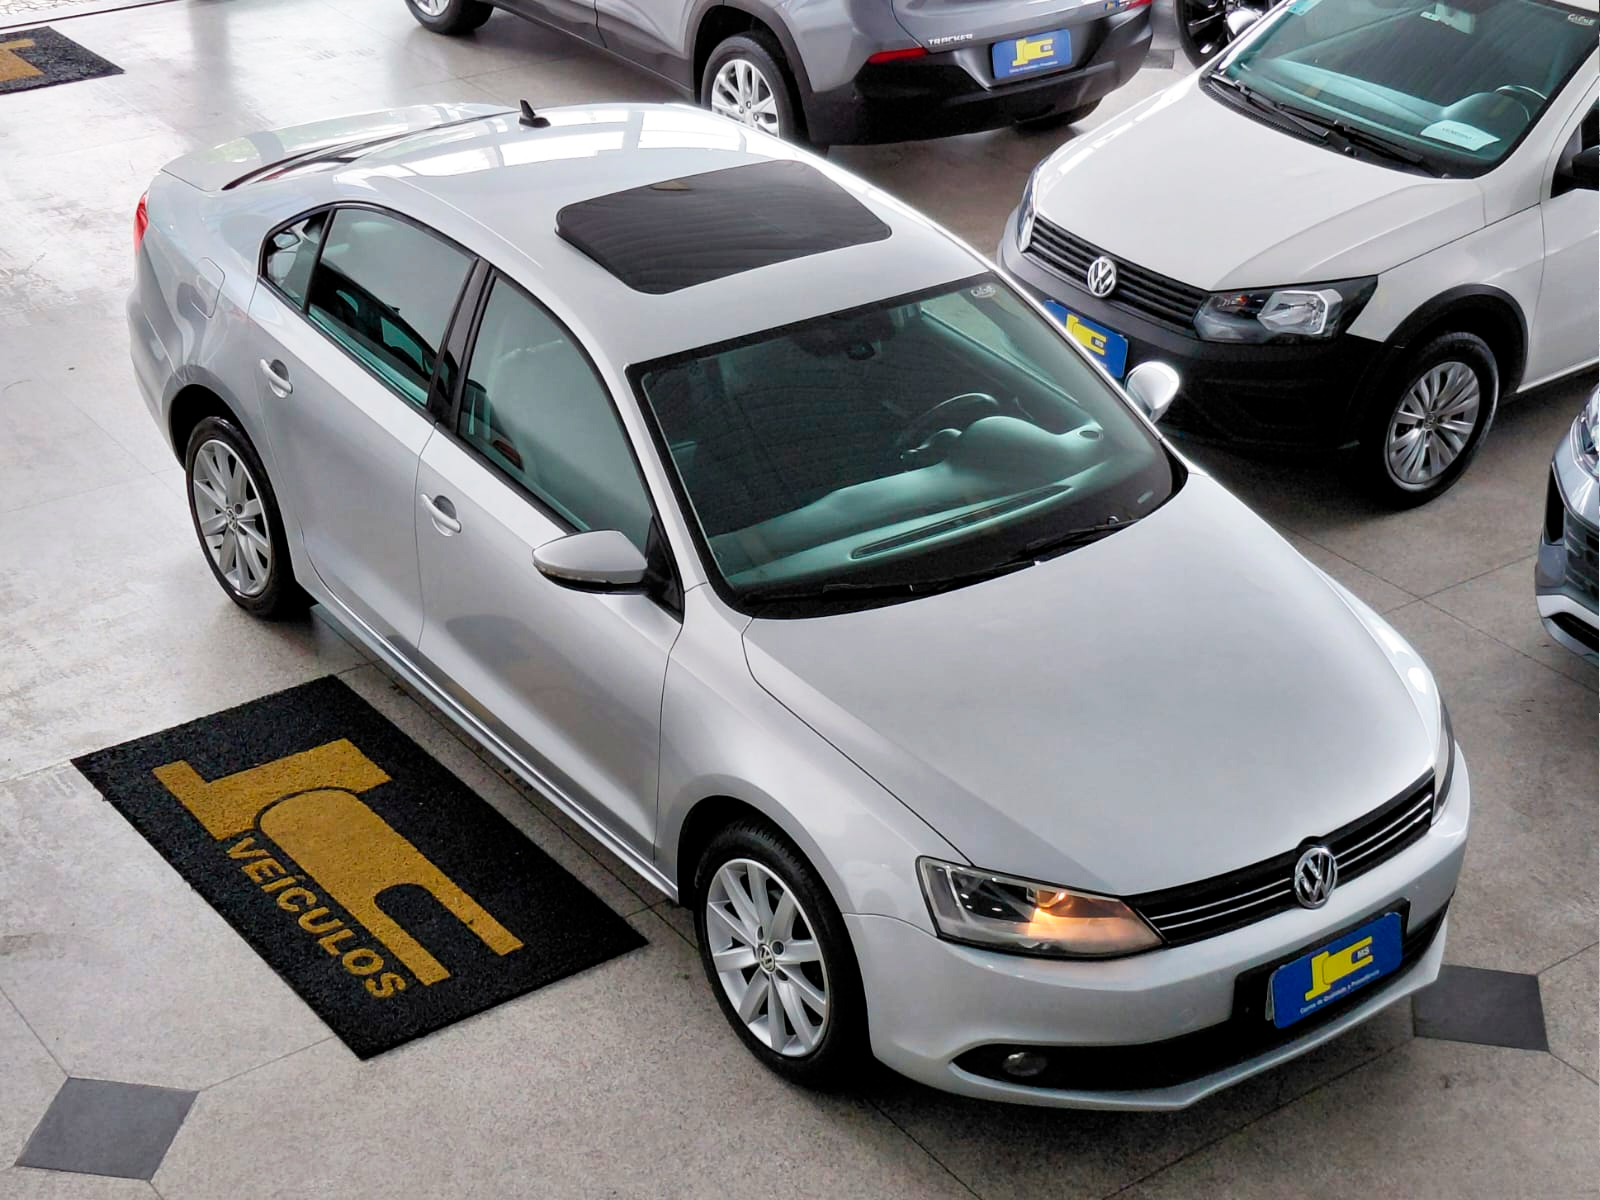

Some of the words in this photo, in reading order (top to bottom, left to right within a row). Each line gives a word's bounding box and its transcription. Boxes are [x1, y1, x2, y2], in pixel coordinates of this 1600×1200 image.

[927, 33, 974, 46] TRACKER
[1294, 847, 1338, 910] VW
[226, 834, 407, 999] VEÍCULOS
